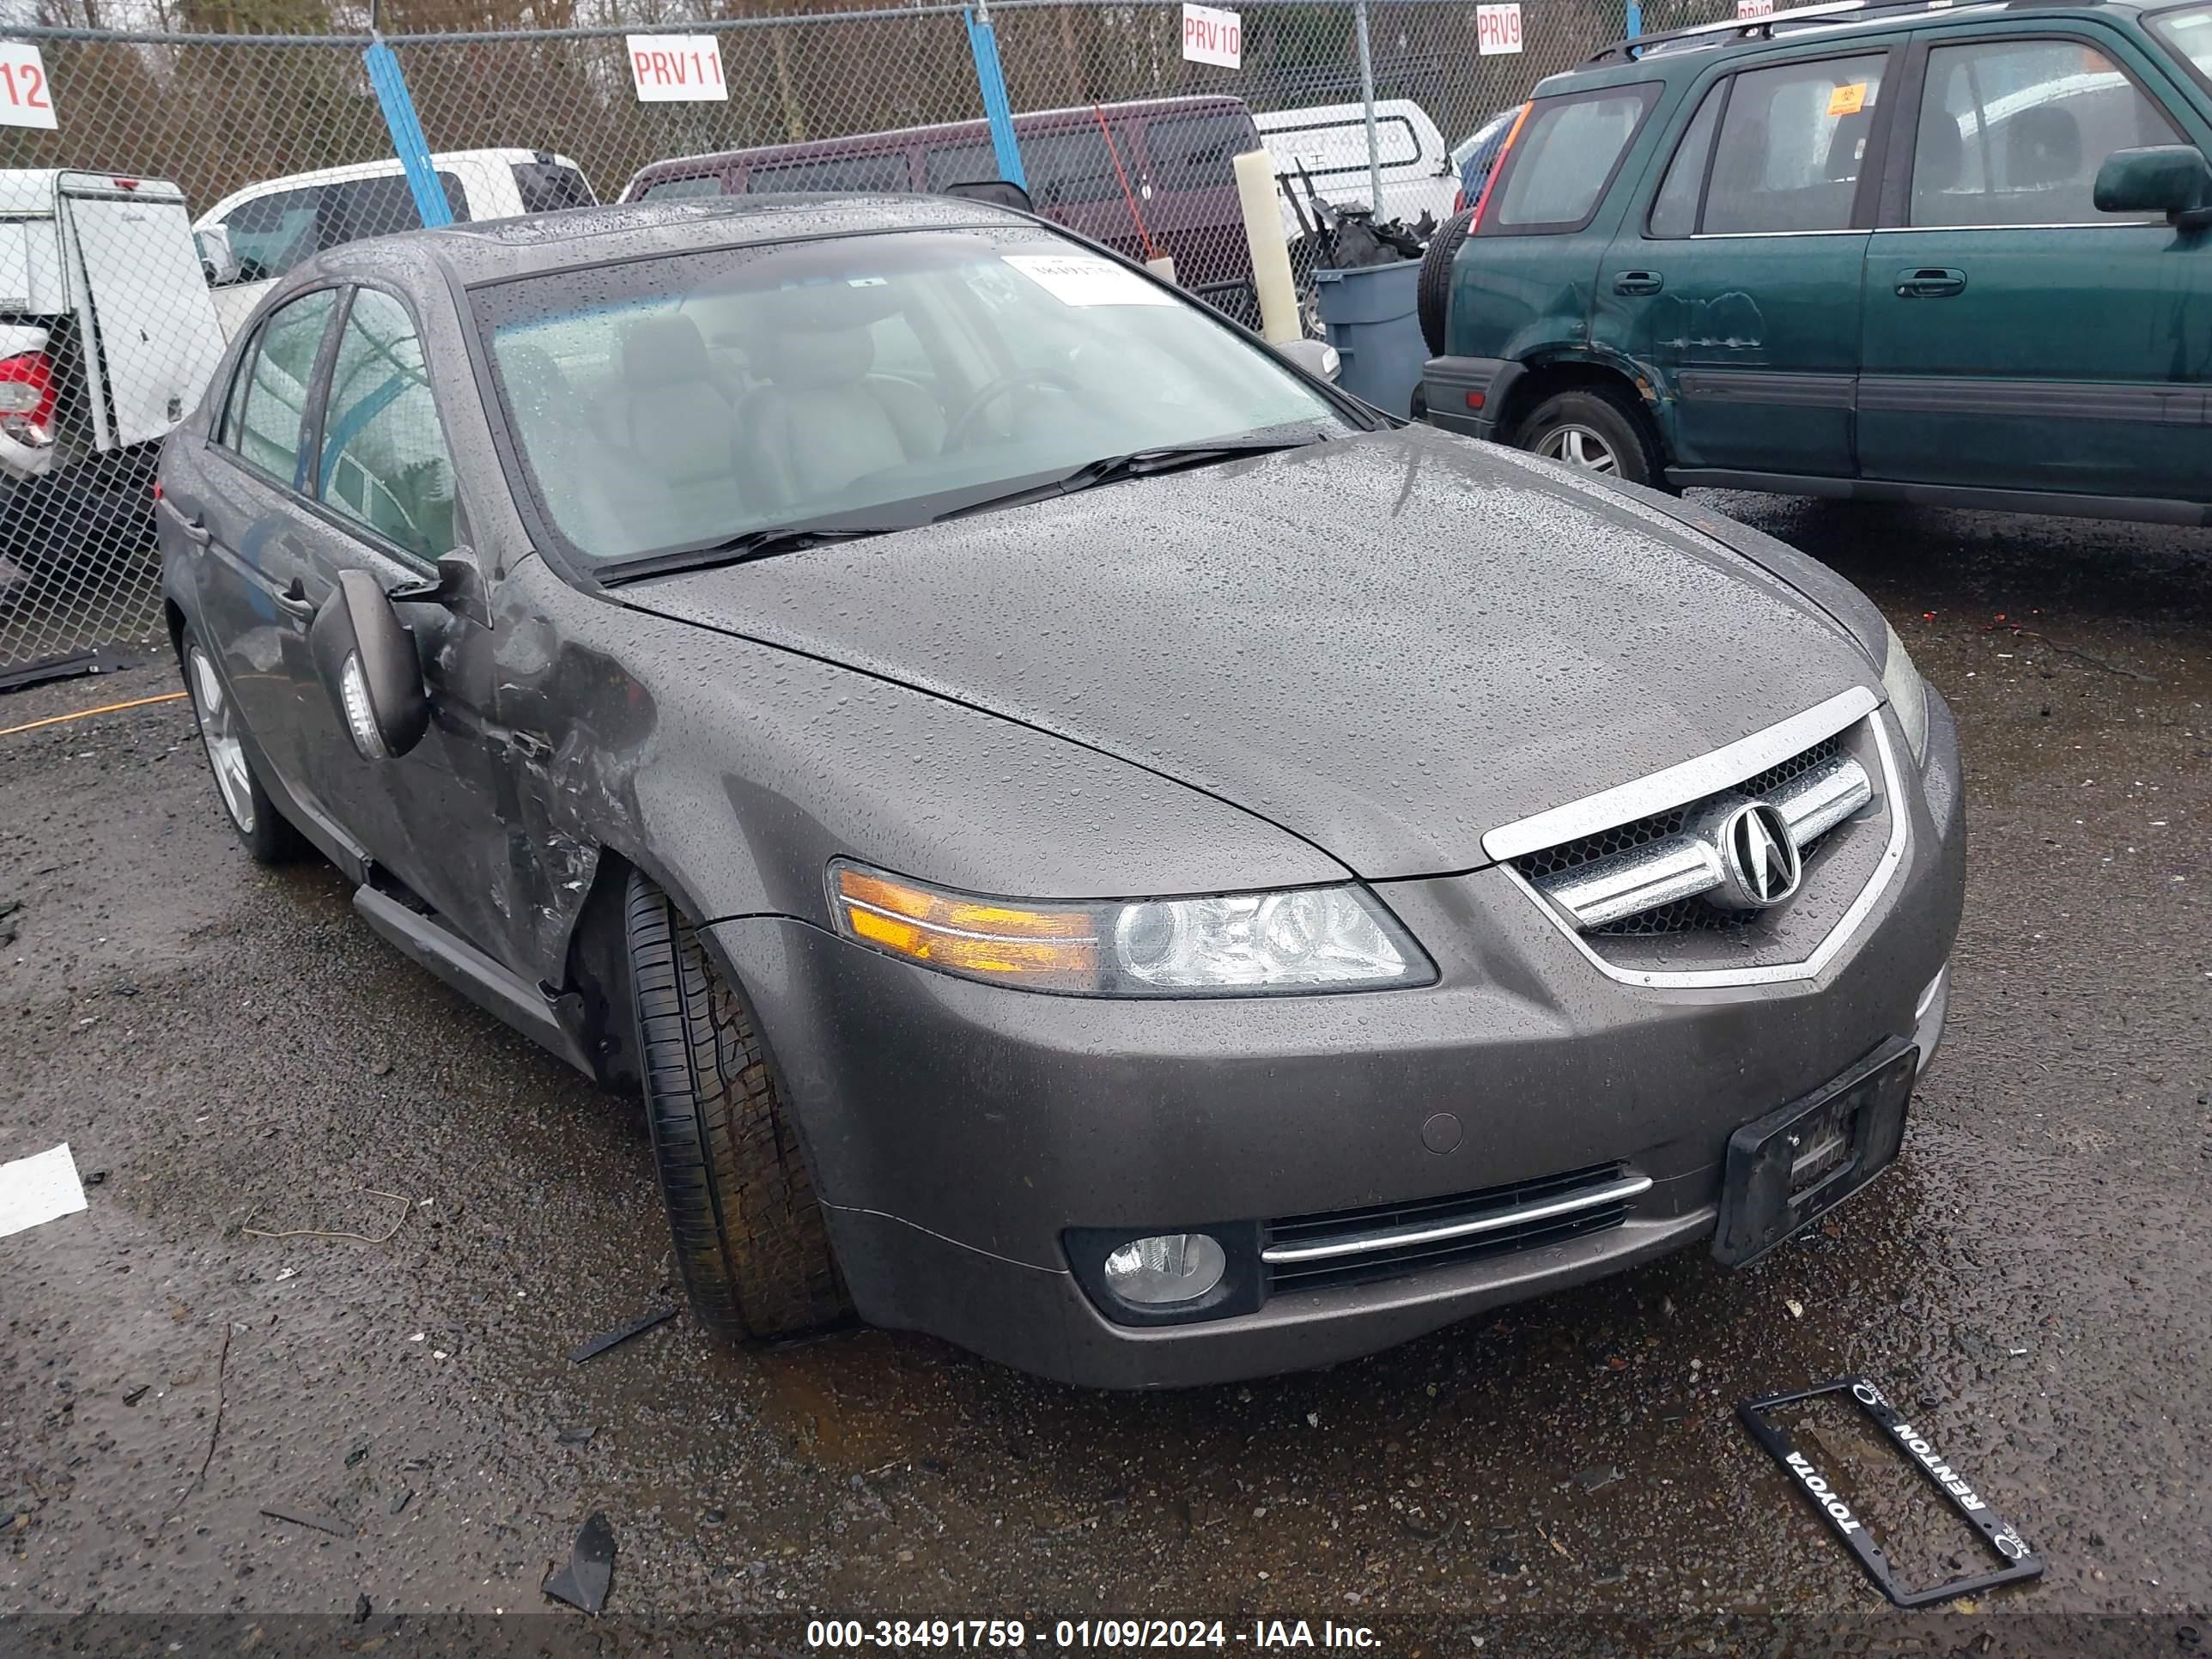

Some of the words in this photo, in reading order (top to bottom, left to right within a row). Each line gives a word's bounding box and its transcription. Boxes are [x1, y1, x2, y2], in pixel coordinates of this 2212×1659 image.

[1185, 17, 1239, 55] PRV10
[1479, 12, 1520, 46] PRV9
[0, 63, 49, 108] 12
[634, 52, 721, 84] PRV11
[1893, 1425, 1985, 1510] RENTON
[1785, 1451, 1861, 1534] TOYOTA
